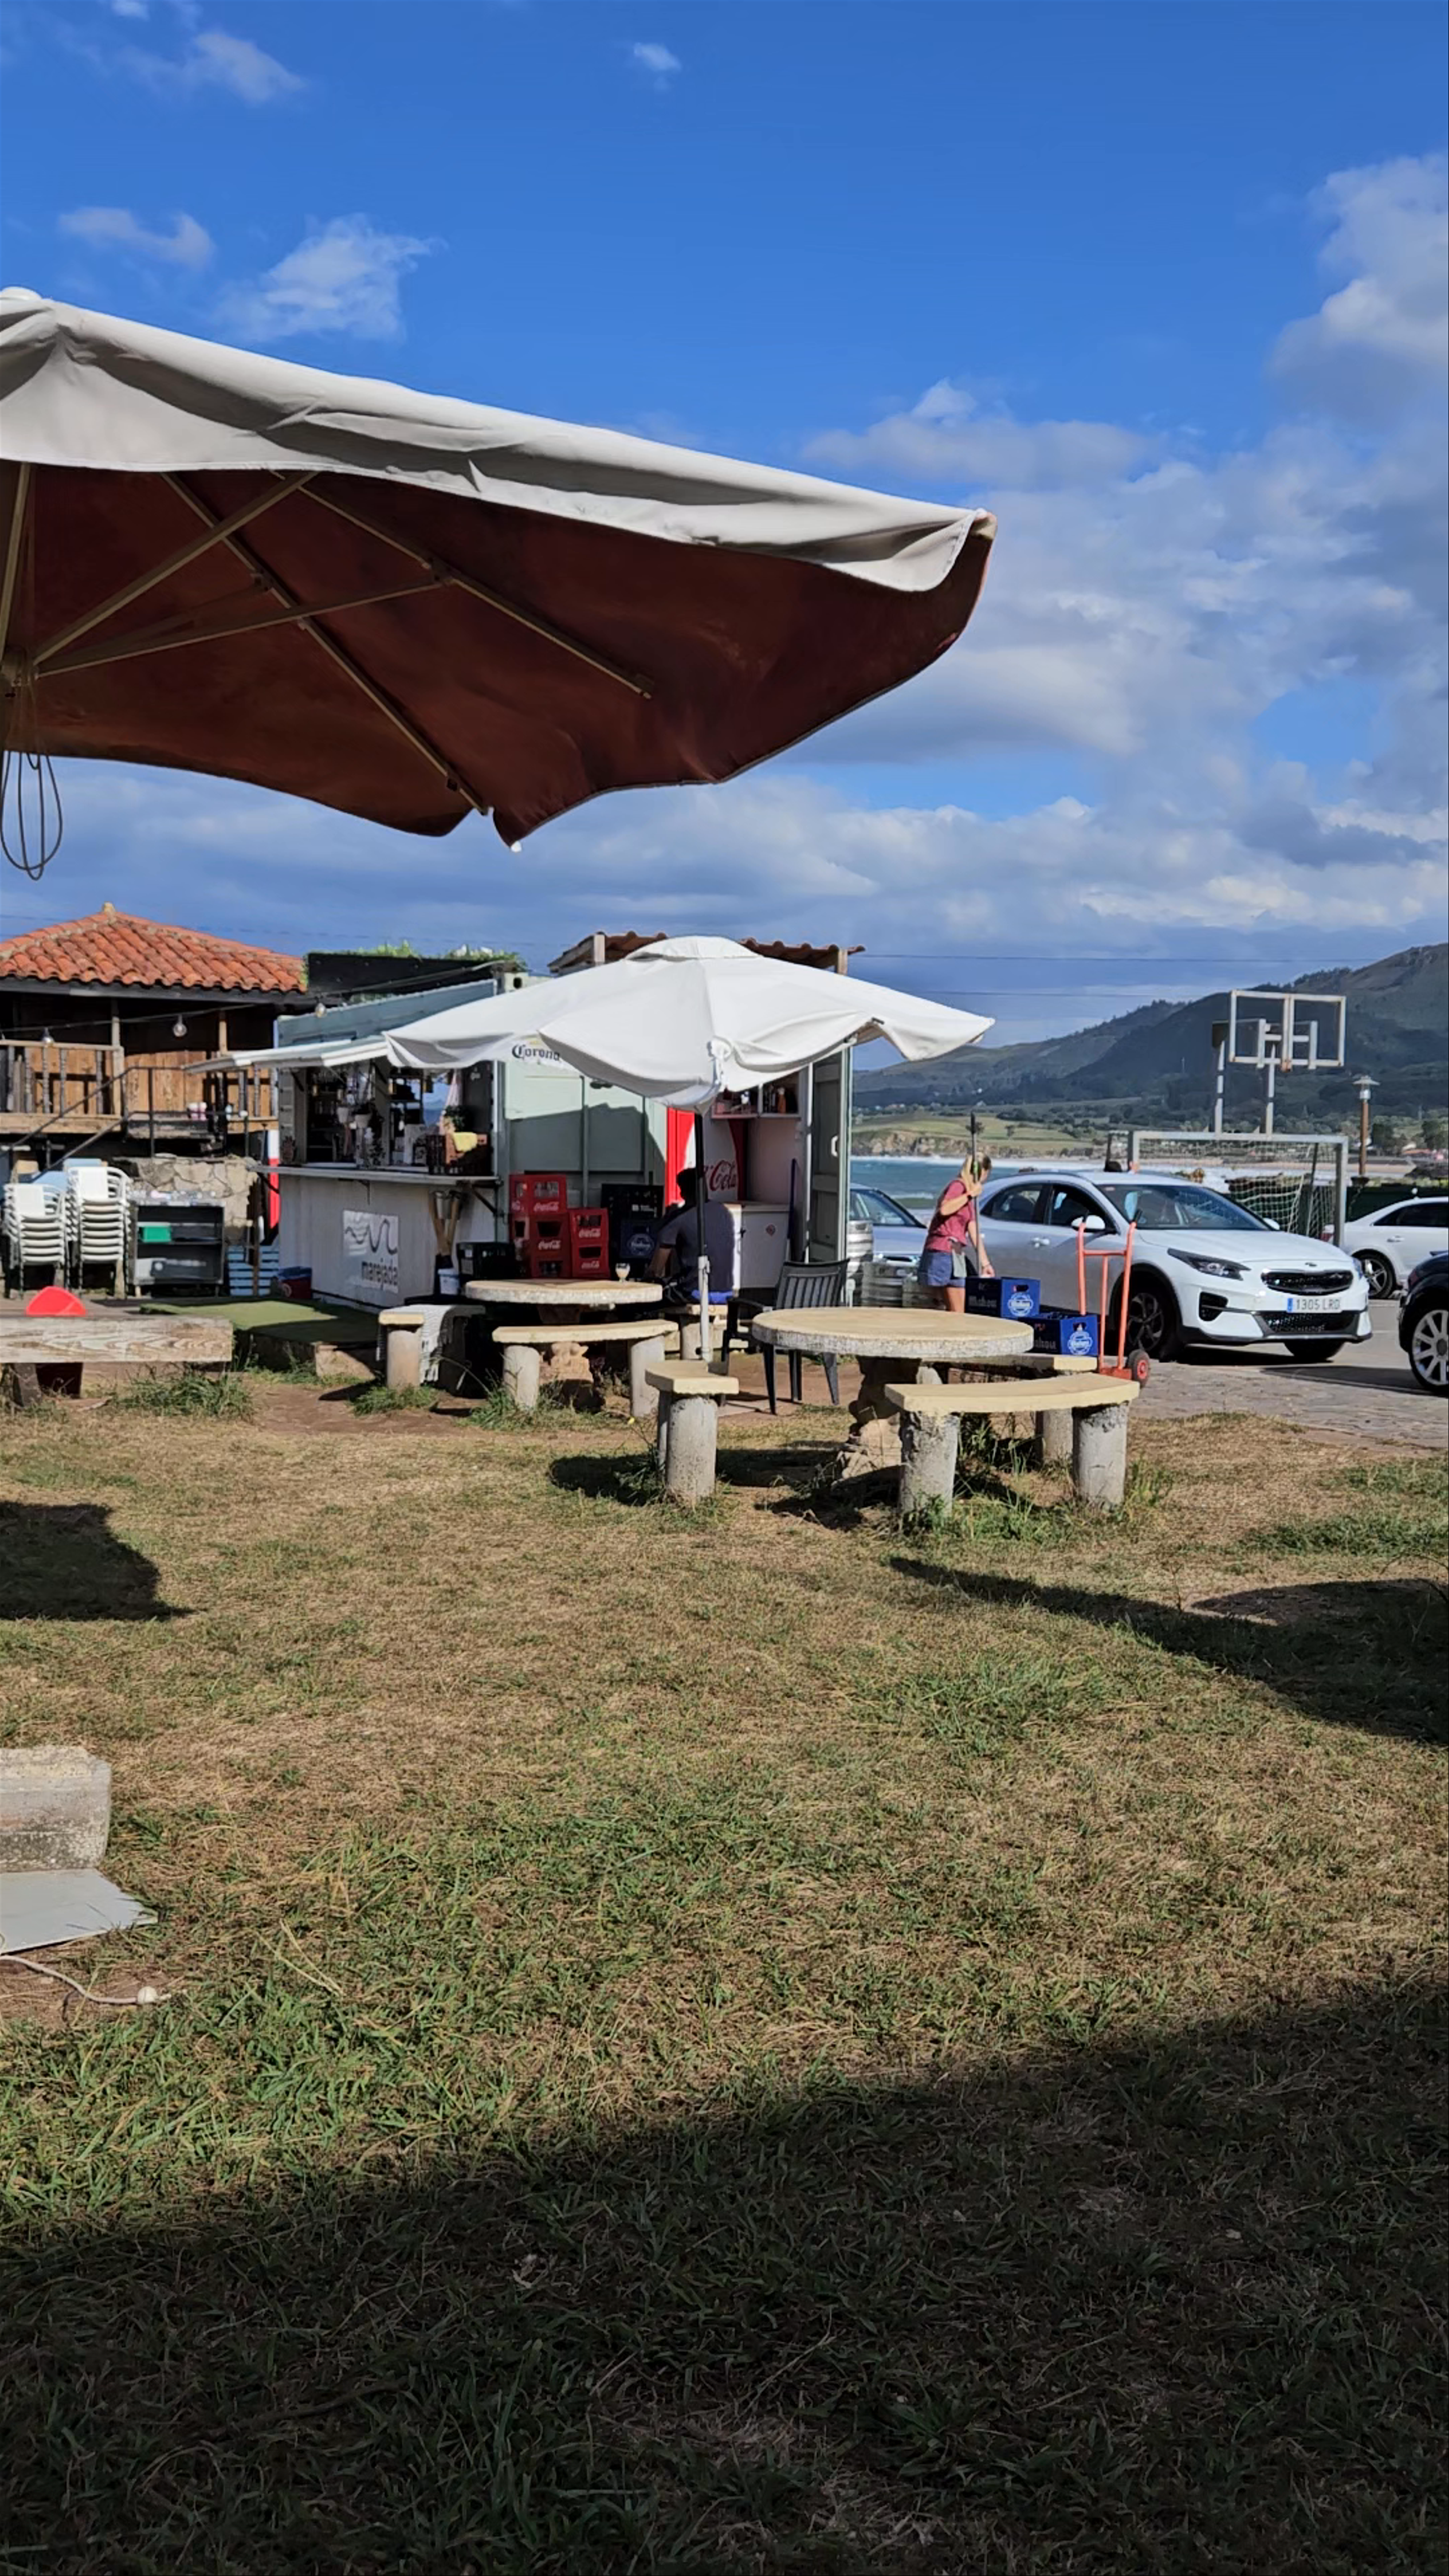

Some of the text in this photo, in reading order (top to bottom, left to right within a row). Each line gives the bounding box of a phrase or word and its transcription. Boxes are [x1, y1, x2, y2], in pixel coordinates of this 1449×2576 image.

[512, 1044, 559, 1061] Corona
[361, 1258, 398, 1290] marejada
[1296, 1299, 1320, 1310] 1305
